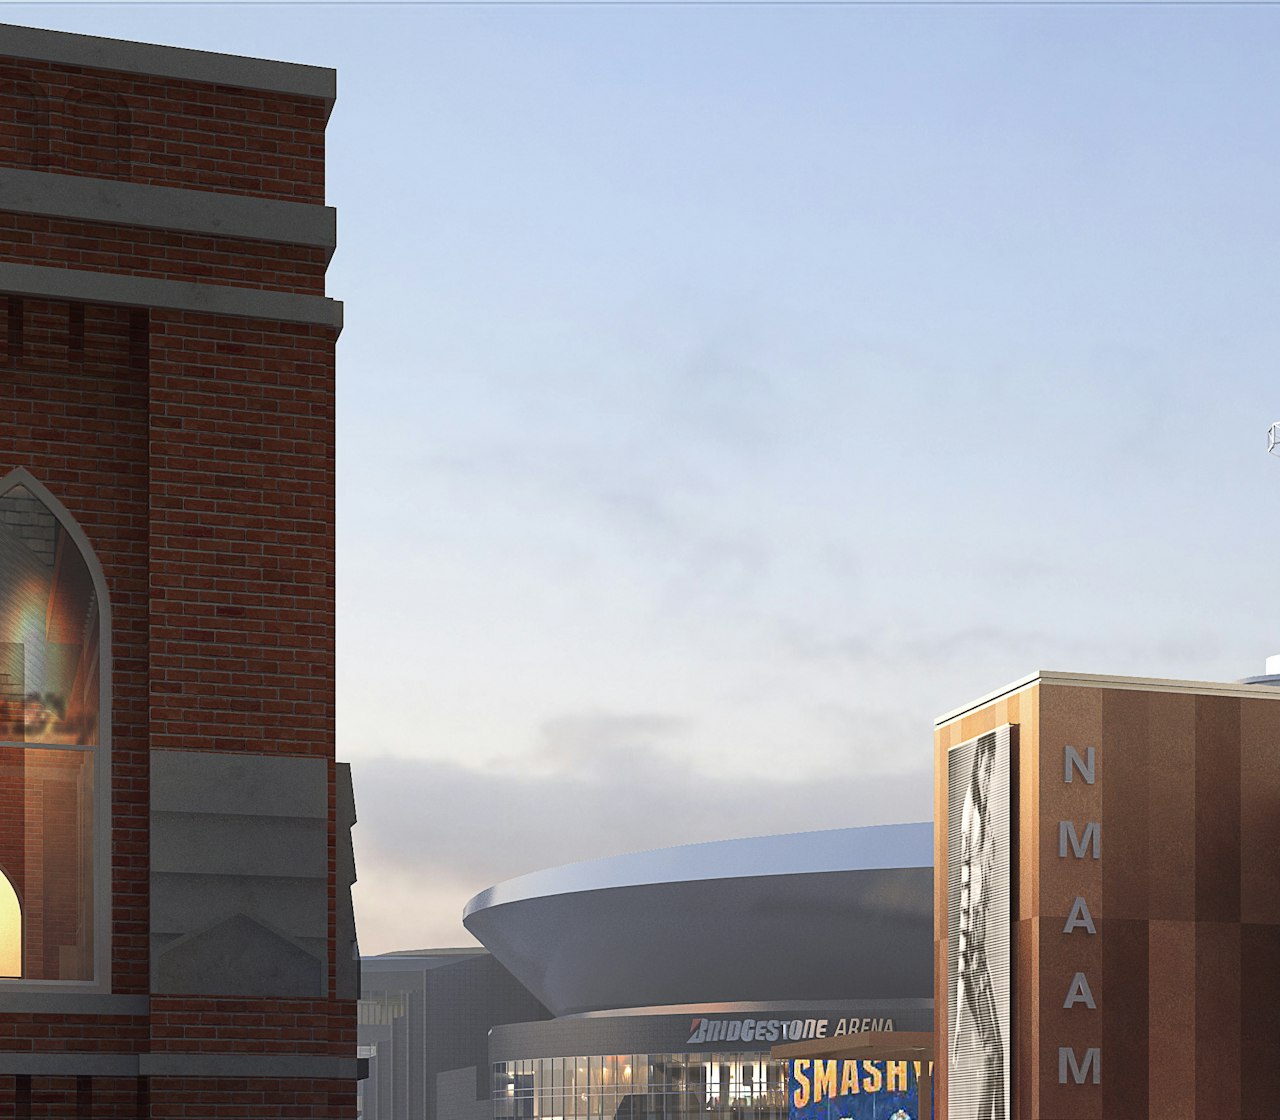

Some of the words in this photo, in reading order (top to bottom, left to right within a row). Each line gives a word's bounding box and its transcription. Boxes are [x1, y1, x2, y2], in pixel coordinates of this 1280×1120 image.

[1058, 744, 1102, 1085] NMAAM
[686, 1018, 829, 1044] BRIDGESTONE
[834, 1018, 894, 1038] ARENA
